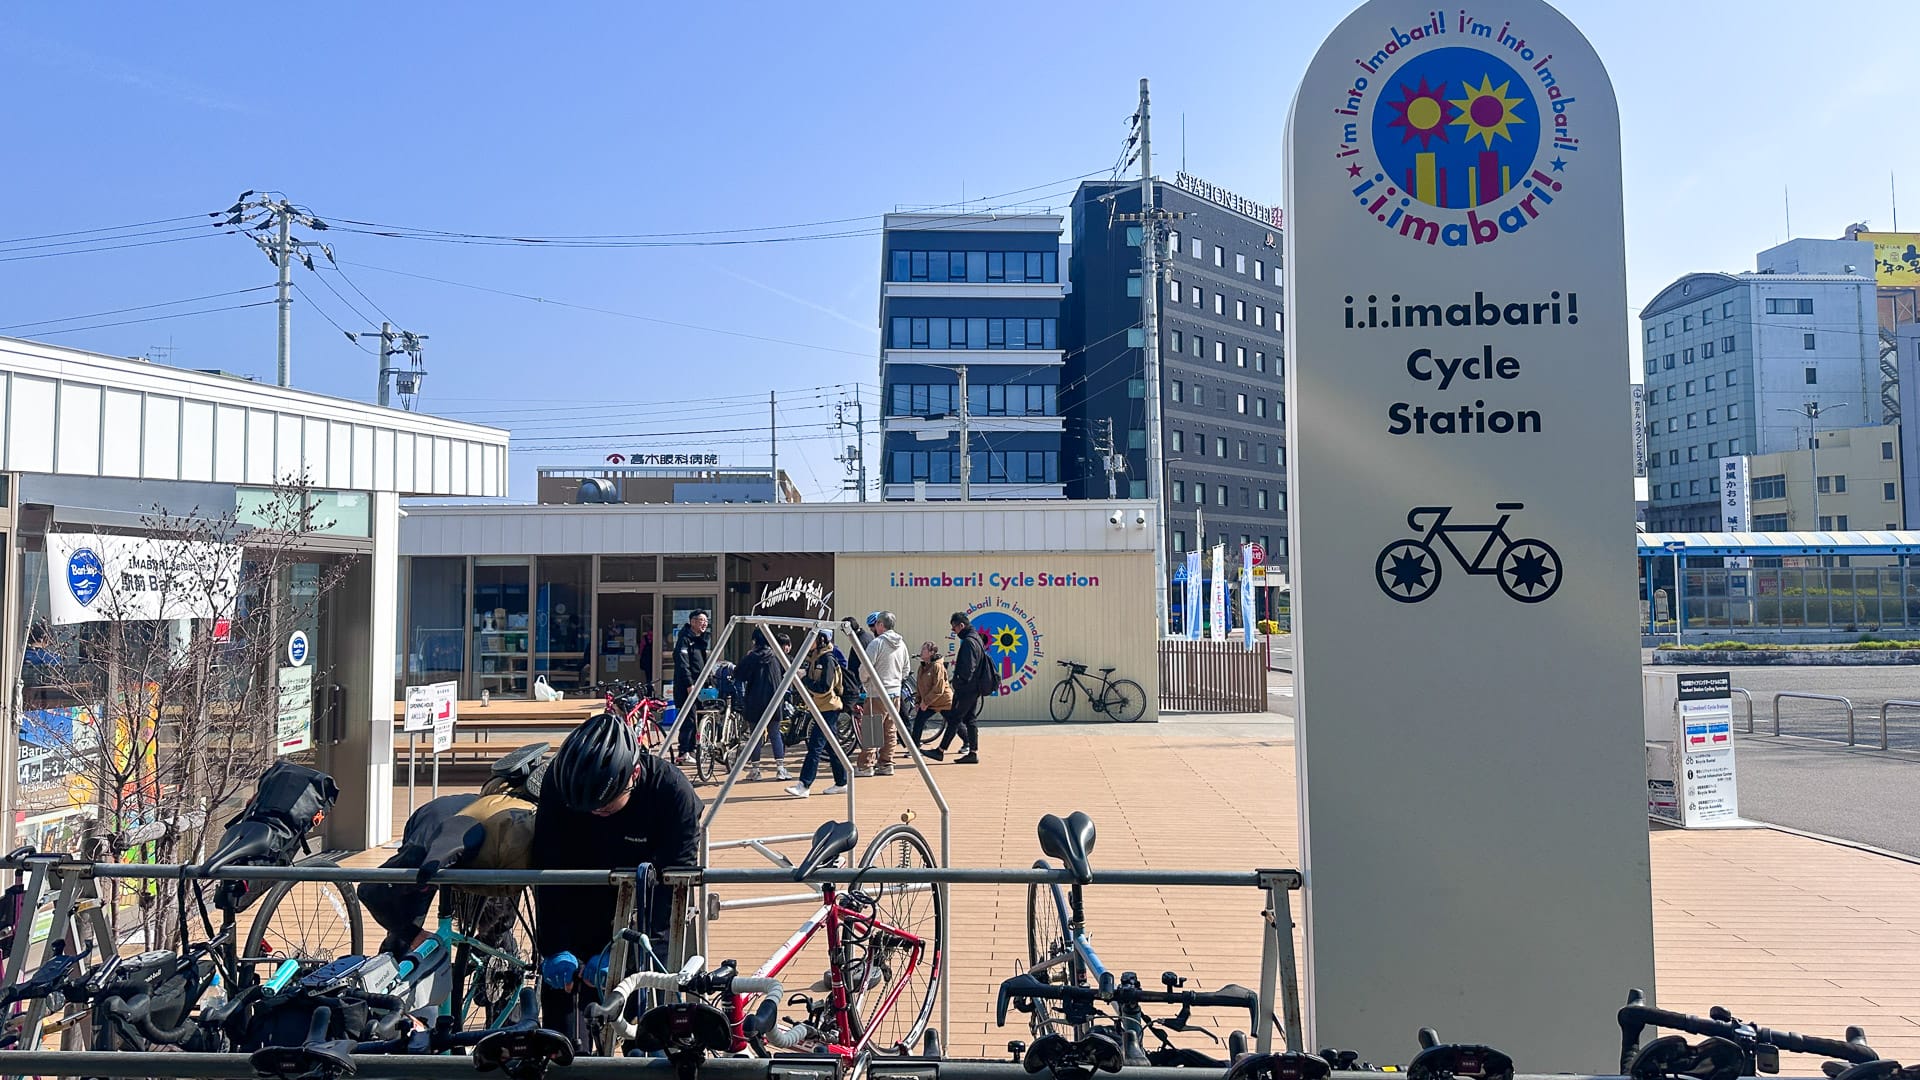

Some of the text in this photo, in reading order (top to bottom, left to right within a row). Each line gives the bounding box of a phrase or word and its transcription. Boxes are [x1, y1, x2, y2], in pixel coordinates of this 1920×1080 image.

[1334, 10, 1446, 159] i'm into imabari!
[1459, 9, 1579, 152] i'm into imabari!
[1176, 170, 1232, 209] STATION
[1352, 169, 1563, 247] i.i.imabari!
[1344, 291, 1578, 329] i.i.imabari!
[1406, 345, 1520, 391] Cycle
[1387, 400, 1542, 435] Station
[630, 454, 718, 465] 高木眼科病院
[890, 572, 1099, 591] i.i.imabari! Cycle Station
[1012, 601, 1028, 619] into
[1026, 616, 1045, 658] imabari!
